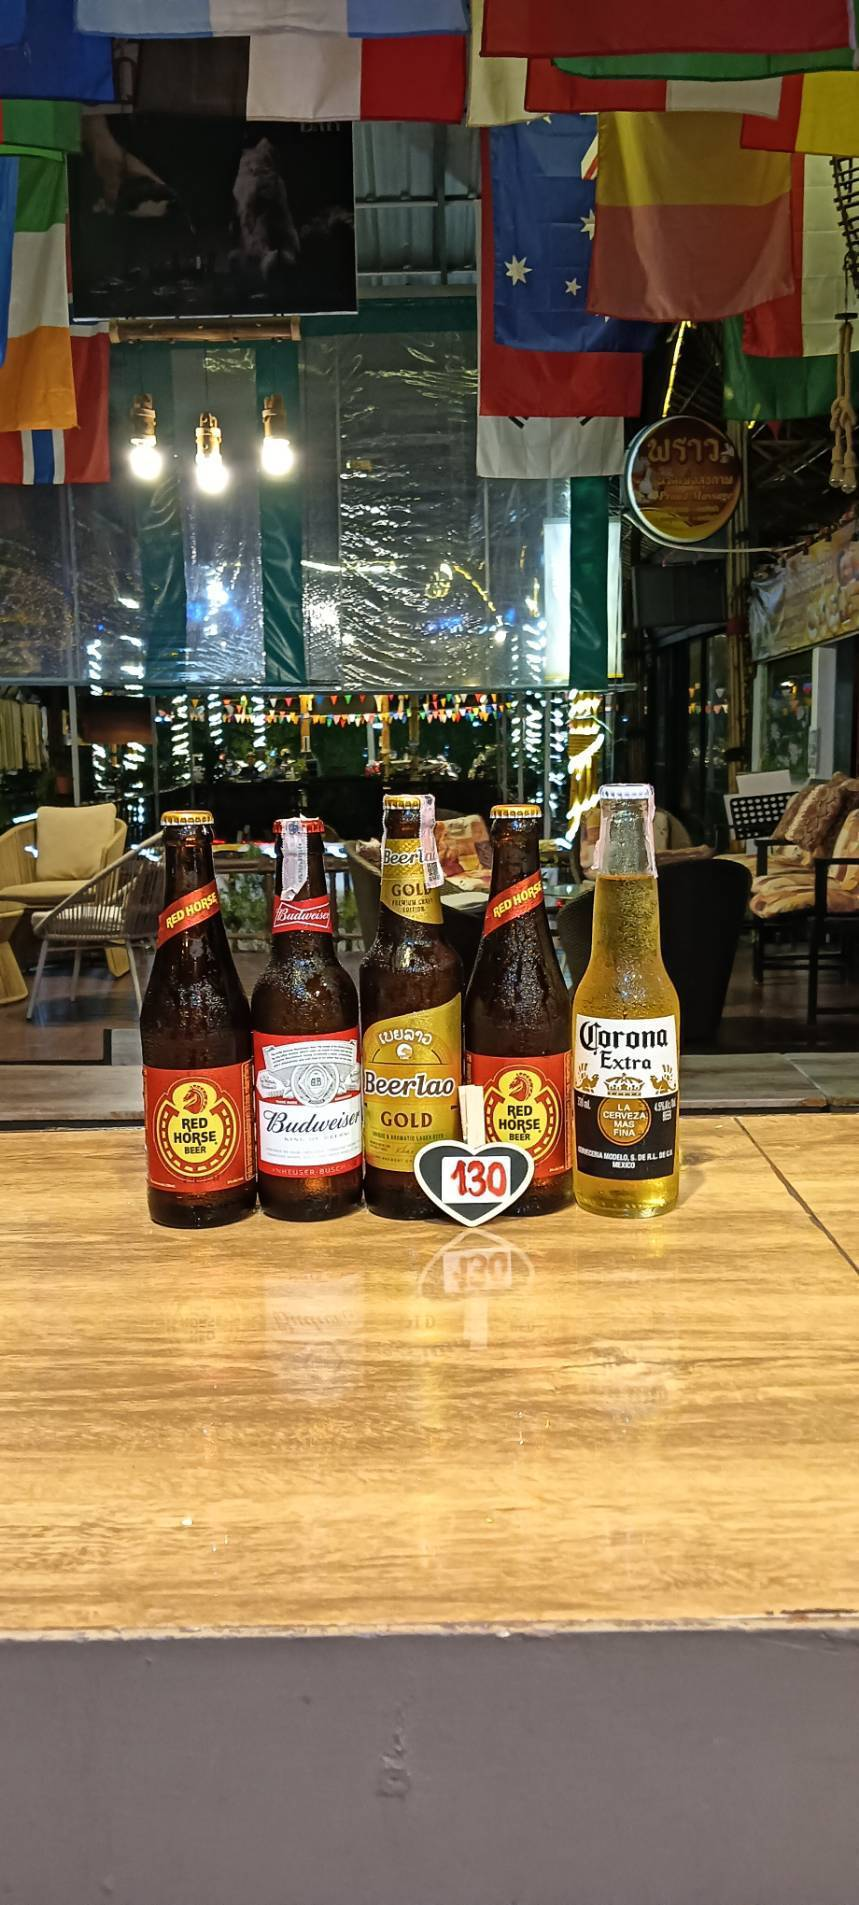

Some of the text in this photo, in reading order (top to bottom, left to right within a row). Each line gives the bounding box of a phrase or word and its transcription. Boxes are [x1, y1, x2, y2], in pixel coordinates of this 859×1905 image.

[647, 436, 720, 463] พราว
[493, 881, 543, 918] RED HORSE
[166, 891, 218, 929] RED HORSE
[378, 1028, 433, 1045] ເບຍລາວ
[579, 1021, 669, 1055] Corona
[600, 1050, 652, 1070] Extra
[364, 1071, 455, 1096] Beerlao
[507, 1105, 533, 1119] RED
[617, 1103, 631, 1111] LA
[263, 1109, 360, 1134] Budweiser
[380, 1111, 433, 1128] GOLD
[603, 1111, 646, 1120] CERVEZA
[182, 1117, 208, 1132] RED
[499, 1119, 541, 1133] HORSE
[614, 1120, 635, 1128] MAS
[174, 1131, 217, 1146] HORSE
[509, 1133, 531, 1141] BEER
[613, 1128, 636, 1137] FINA
[184, 1146, 206, 1154] BEER
[638, 1152, 646, 1161] DE
[451, 1160, 507, 1197] 130
